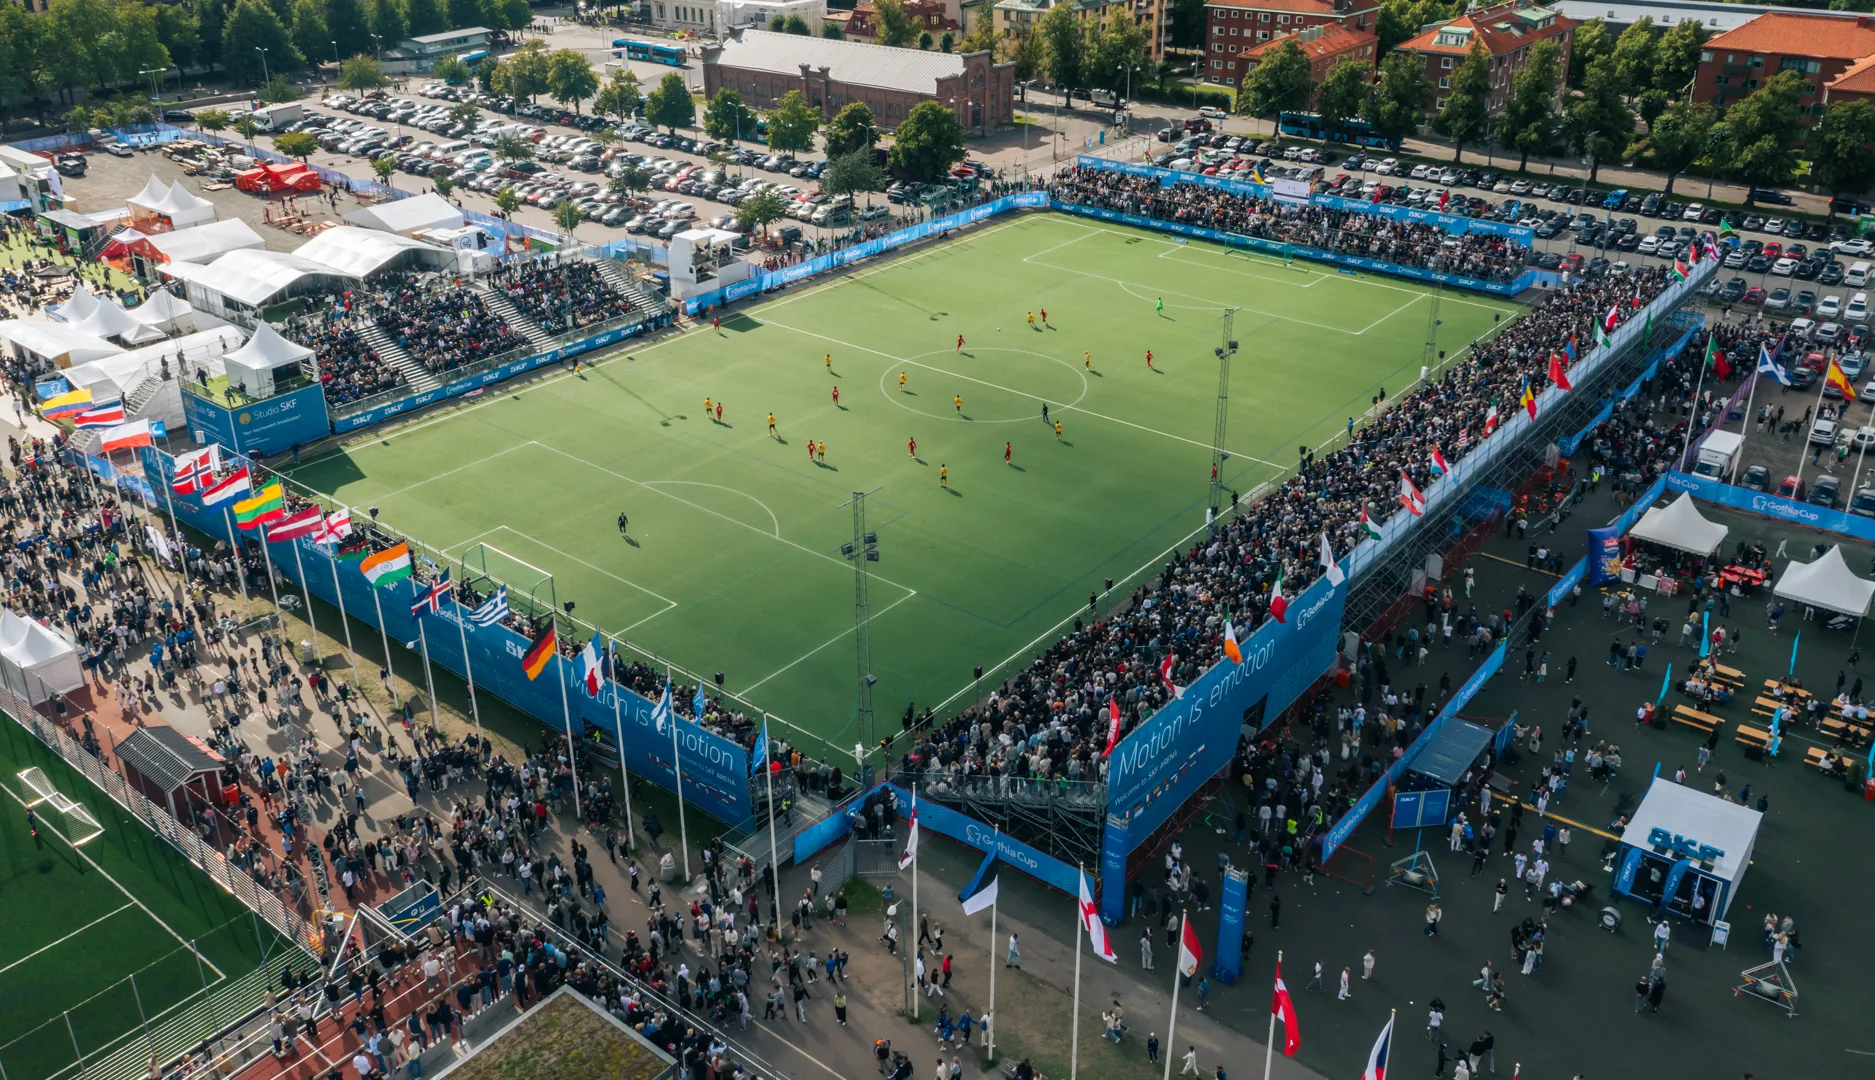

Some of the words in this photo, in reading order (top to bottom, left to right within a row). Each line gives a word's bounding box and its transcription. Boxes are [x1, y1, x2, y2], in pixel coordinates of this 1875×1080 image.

[253, 405, 280, 420] Studio
[280, 398, 297, 412] SKF
[352, 413, 373, 426] SKF
[1681, 479, 1700, 491] Cup
[505, 639, 528, 660] SK
[635, 700, 649, 727] is
[1117, 714, 1183, 787] Motion
[1188, 695, 1203, 726] is
[1209, 638, 1275, 708] emotion
[982, 834, 1017, 858] Gthia
